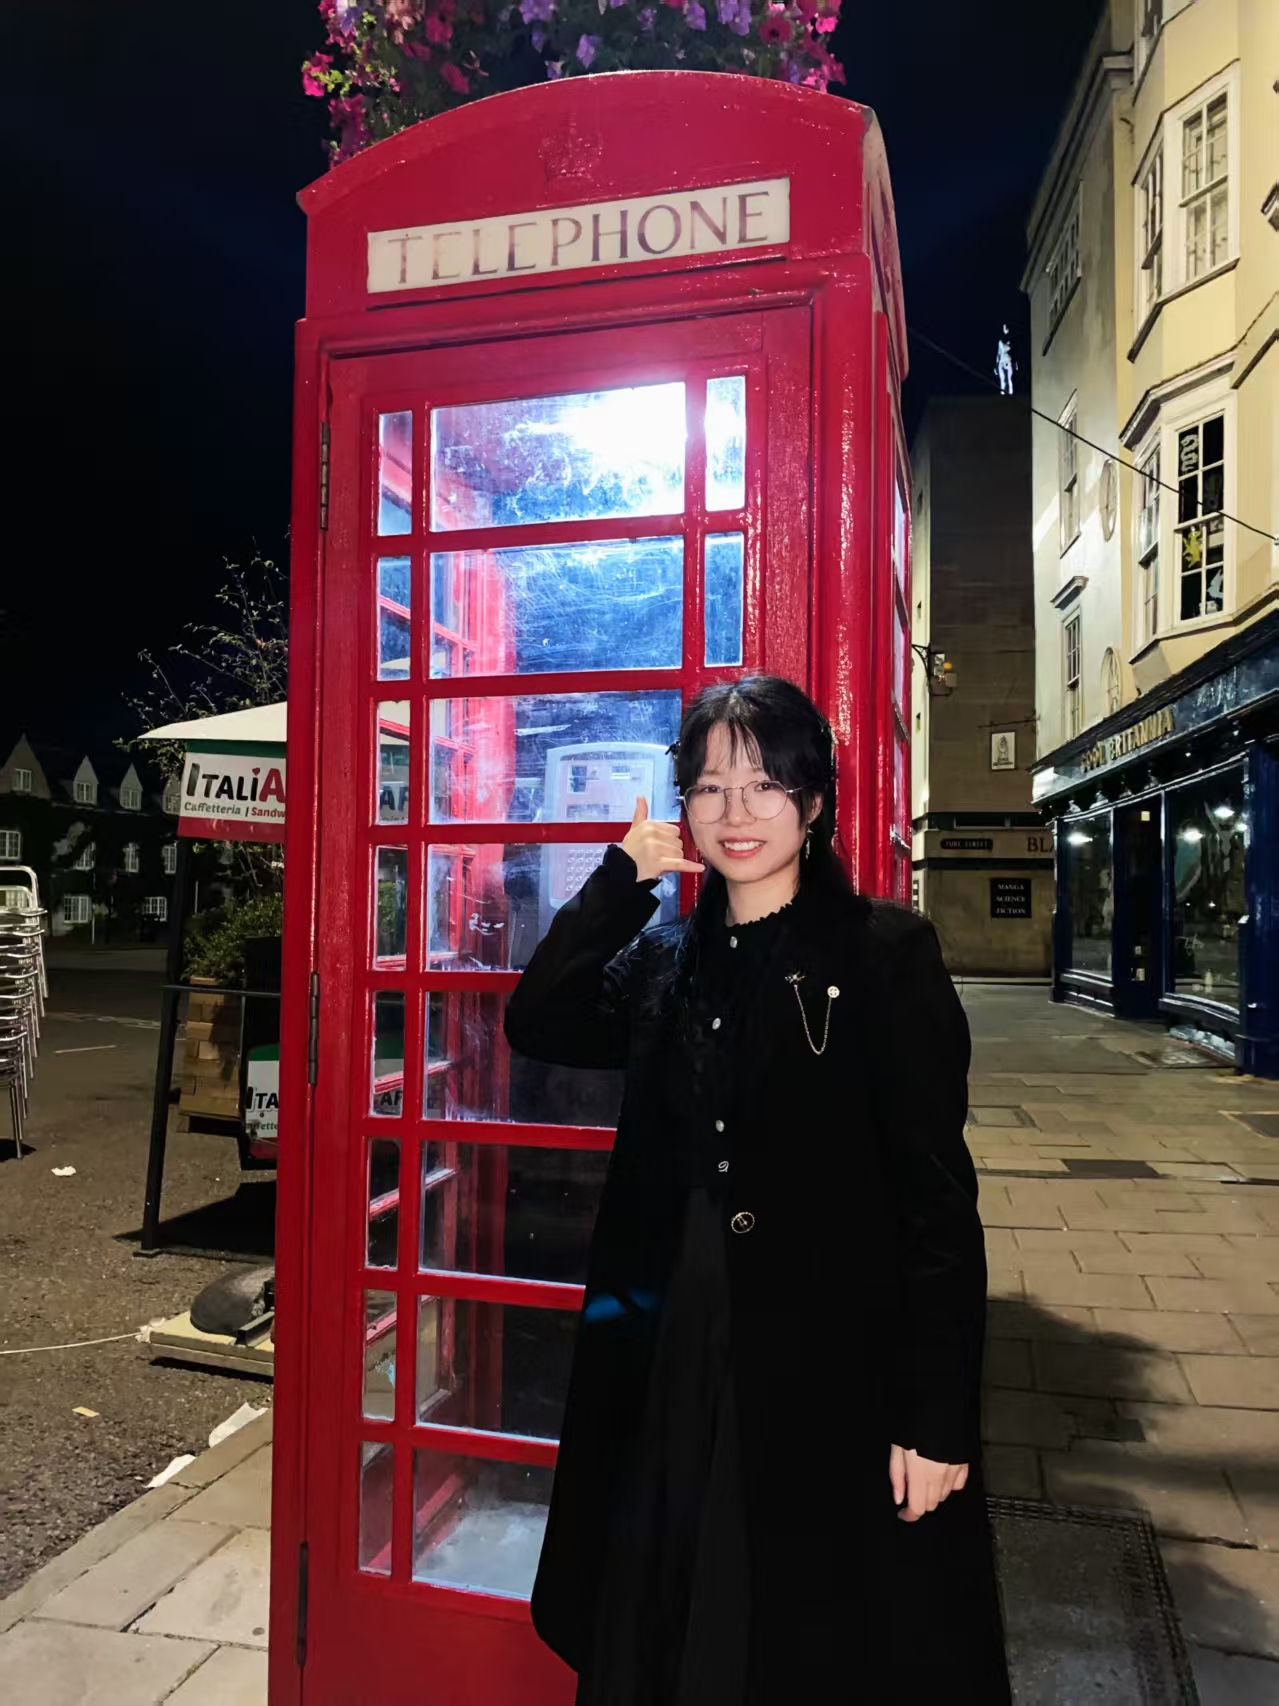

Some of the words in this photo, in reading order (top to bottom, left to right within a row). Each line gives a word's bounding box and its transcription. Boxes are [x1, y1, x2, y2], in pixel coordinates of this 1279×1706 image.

[387, 190, 770, 285] TELEPHONE
[1106, 704, 1175, 761] BRITANNIA
[184, 801, 241, 815] Caffetteria
